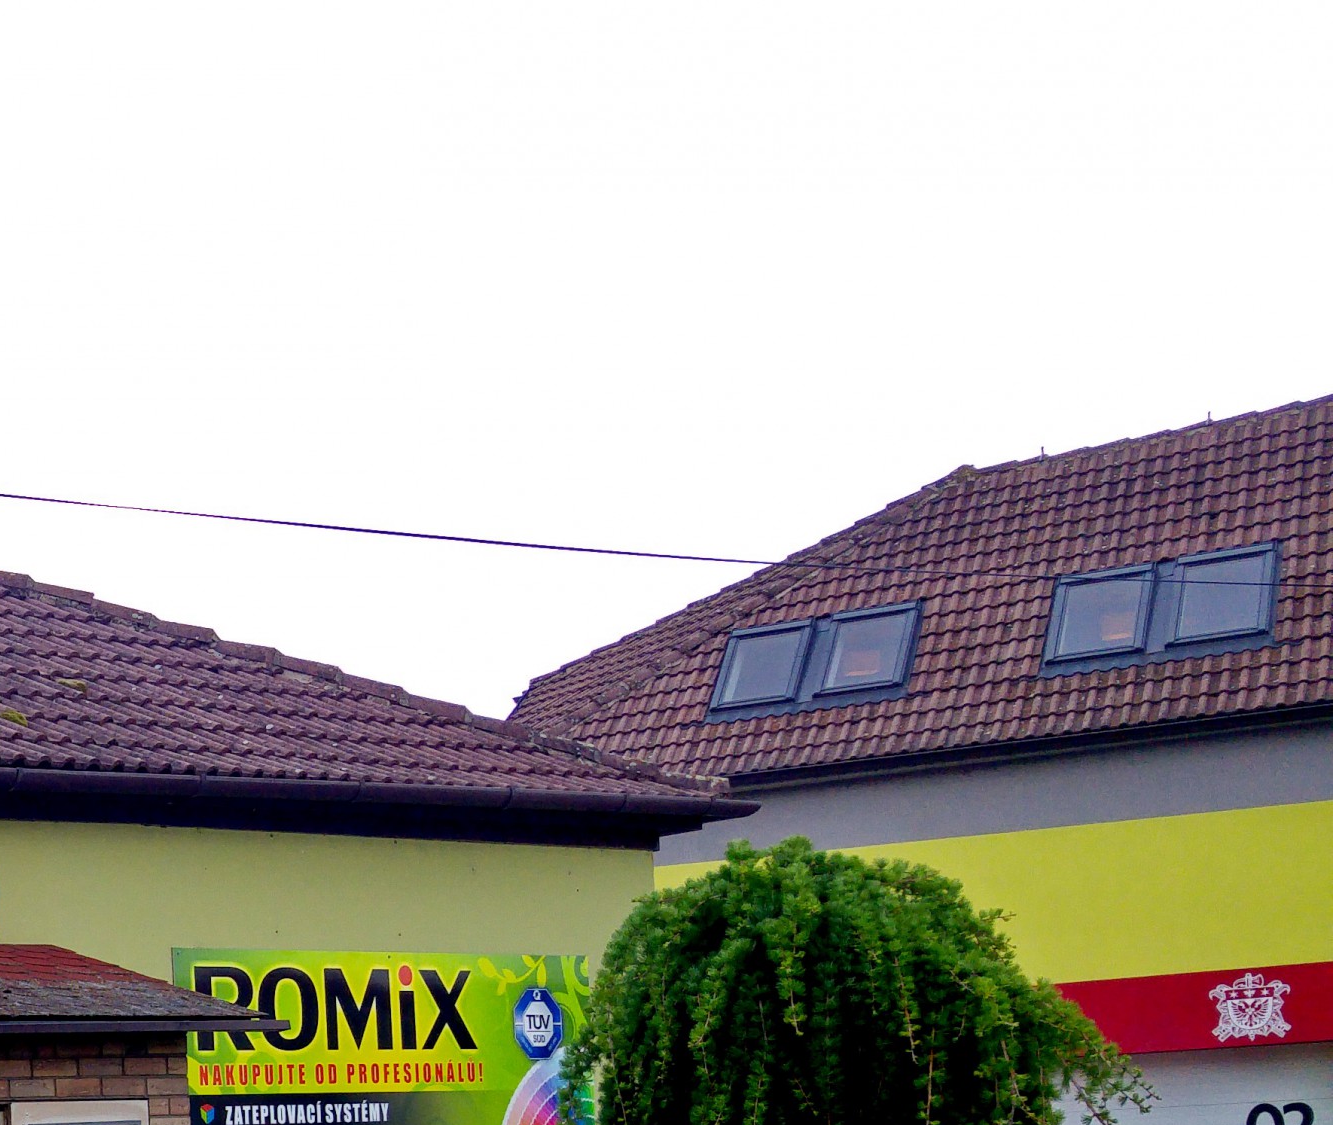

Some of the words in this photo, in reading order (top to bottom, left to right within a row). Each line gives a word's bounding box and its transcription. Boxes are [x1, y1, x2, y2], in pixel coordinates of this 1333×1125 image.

[526, 1015, 550, 1029] TÜV
[199, 1063, 306, 1086] NAKUPUJTE
[316, 1063, 338, 1085] OD
[347, 1060, 484, 1084] PROFESIONÁLŮ!
[225, 1101, 321, 1125] ZATEPLOVACÍ
[325, 1101, 390, 1124] SYSTÉMY
